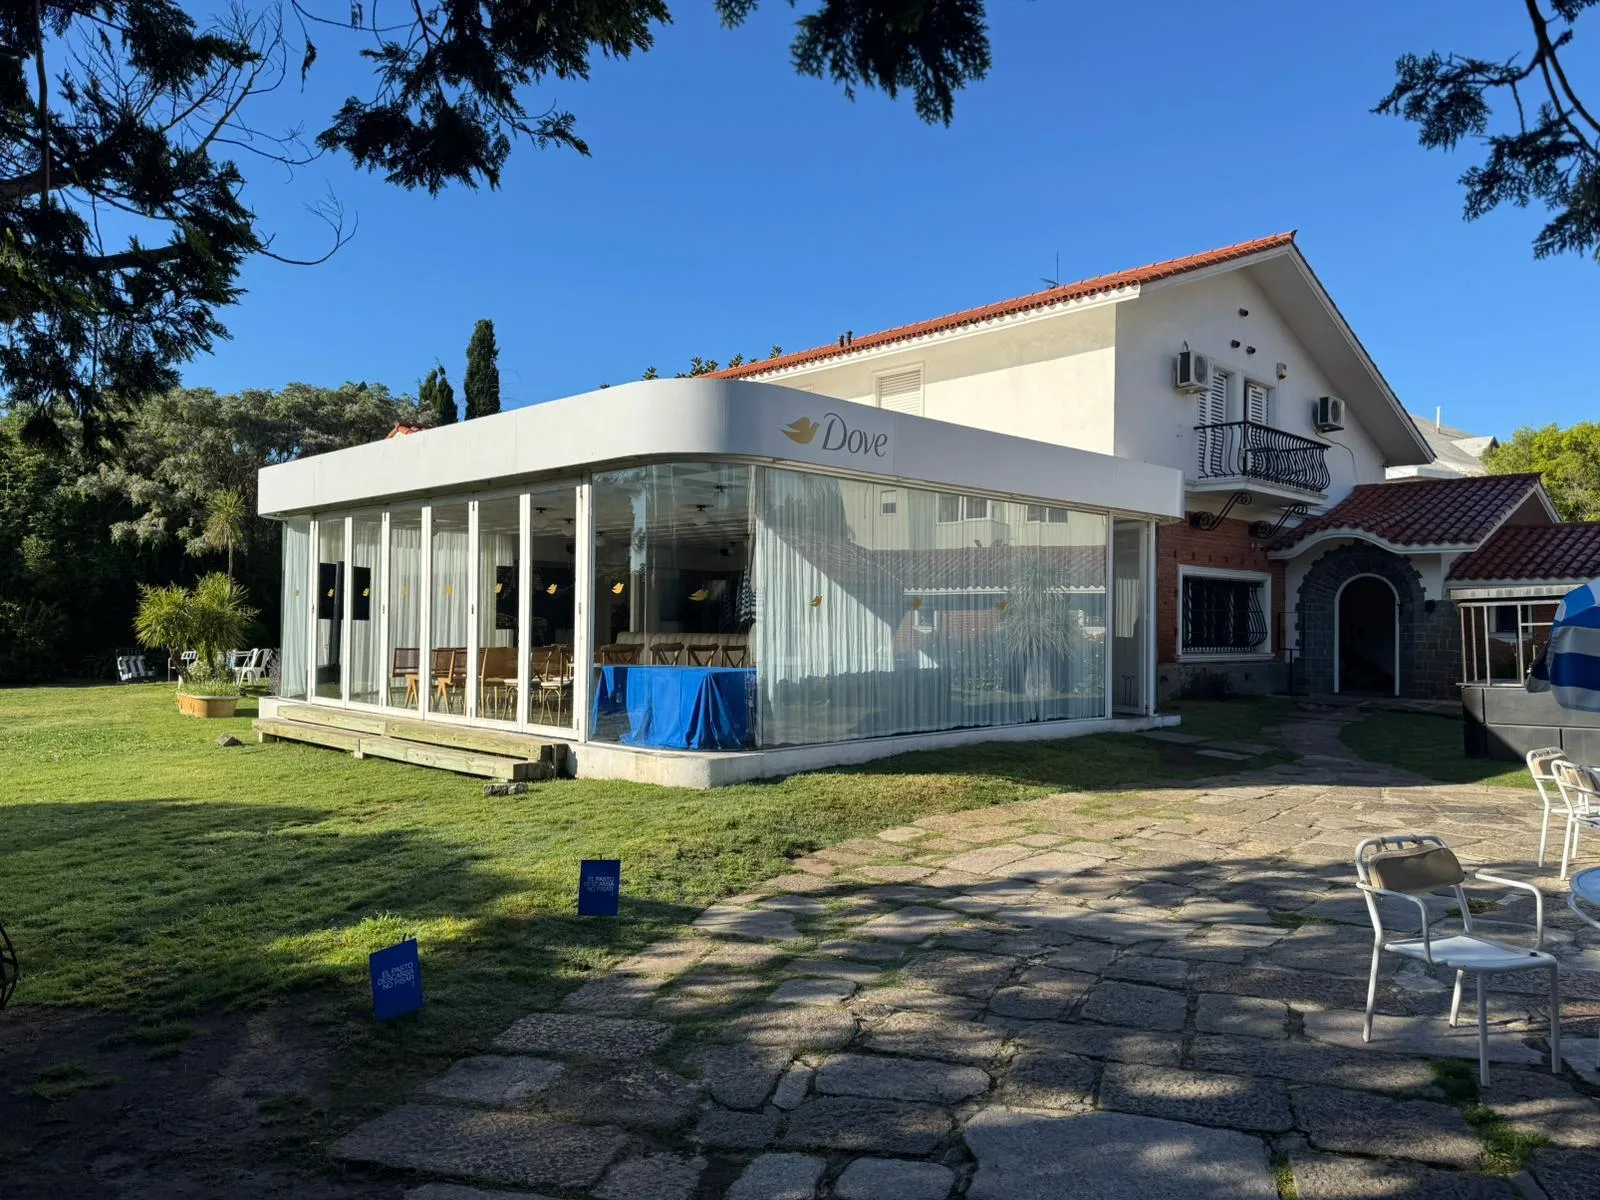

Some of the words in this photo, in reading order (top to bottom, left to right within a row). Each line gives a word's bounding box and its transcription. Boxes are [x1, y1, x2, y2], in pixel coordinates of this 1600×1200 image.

[822, 412, 889, 458] Dove
[377, 968, 415, 986] DESCANSA
[391, 961, 414, 976] PASTO
[382, 981, 393, 991] NO
[394, 974, 415, 987] PISAR
